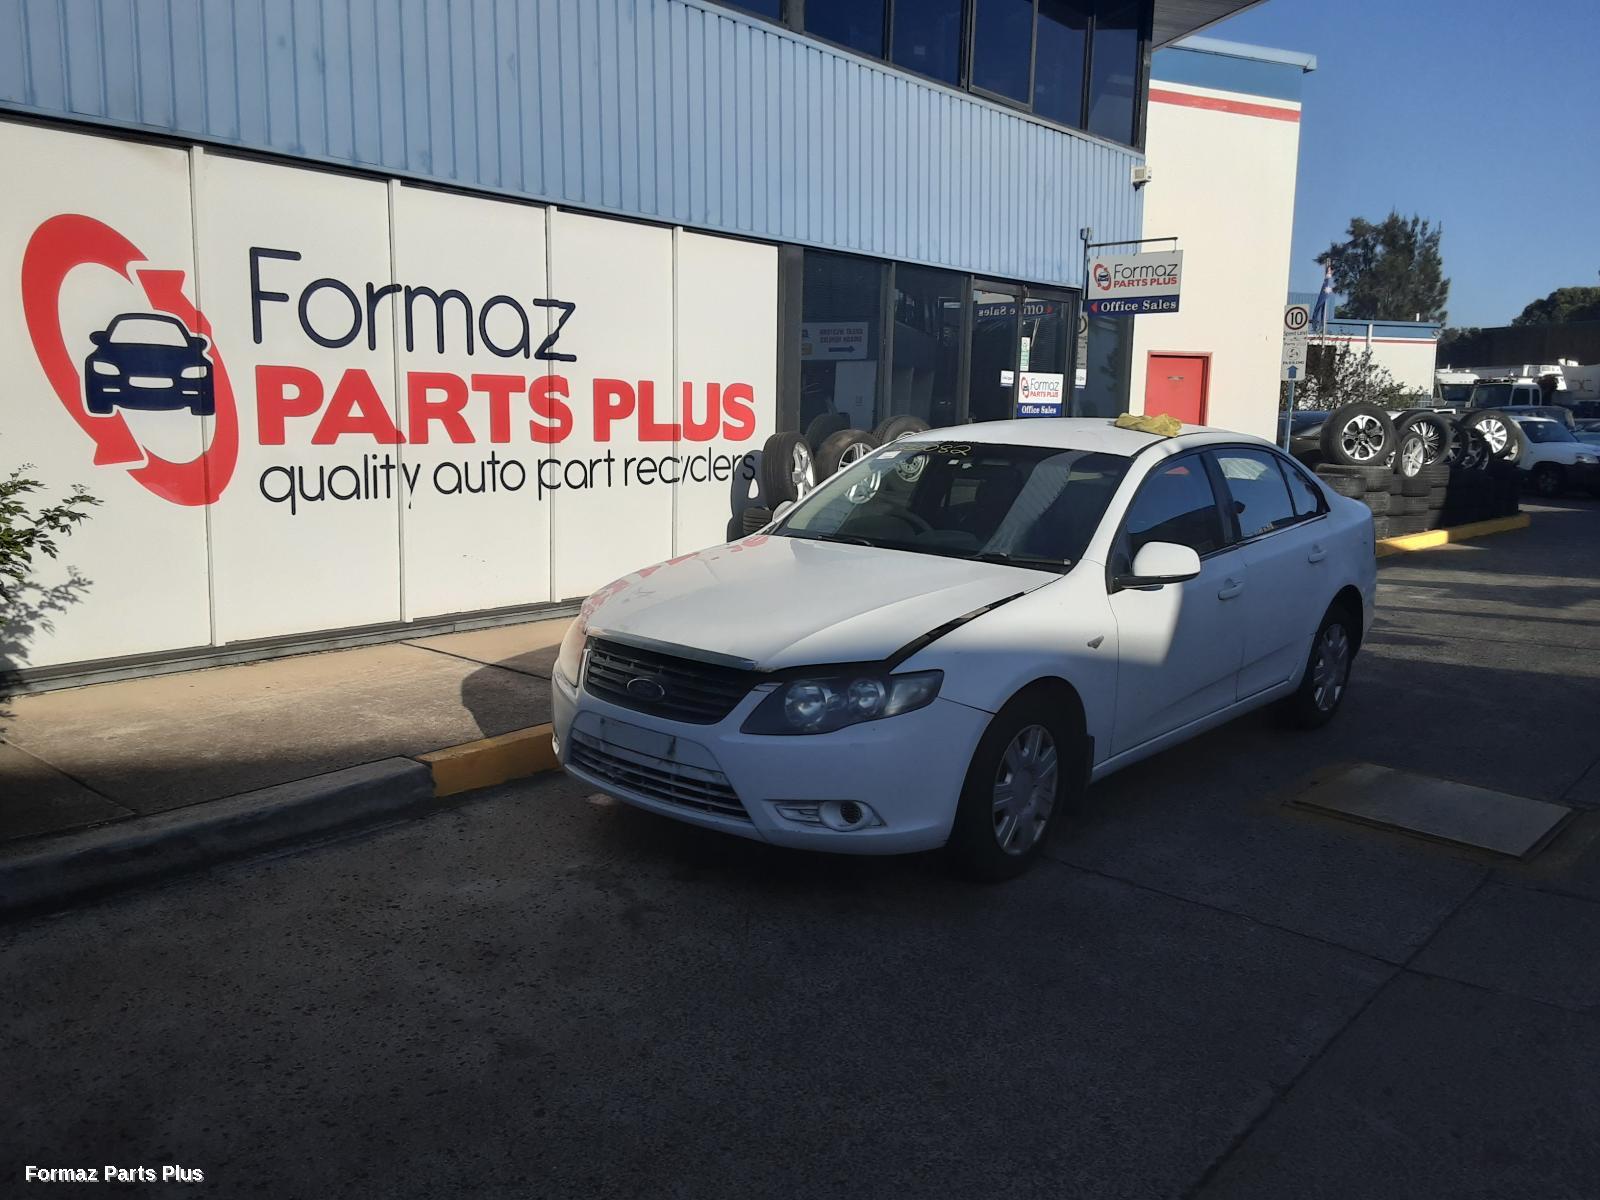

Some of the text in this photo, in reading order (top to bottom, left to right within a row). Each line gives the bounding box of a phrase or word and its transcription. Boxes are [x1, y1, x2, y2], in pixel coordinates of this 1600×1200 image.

[1114, 264, 1178, 279] Formaz
[1114, 277, 1178, 288] PARTS PLUS
[250, 246, 577, 362] Formaz
[1101, 300, 1176, 312] Office Sales
[1291, 312, 1303, 325] 10
[1030, 378, 1060, 391] Formaz
[256, 365, 756, 445] PARTS PLUS
[1021, 405, 1057, 414] Office Sales
[260, 446, 757, 515] quality auto part recyclers
